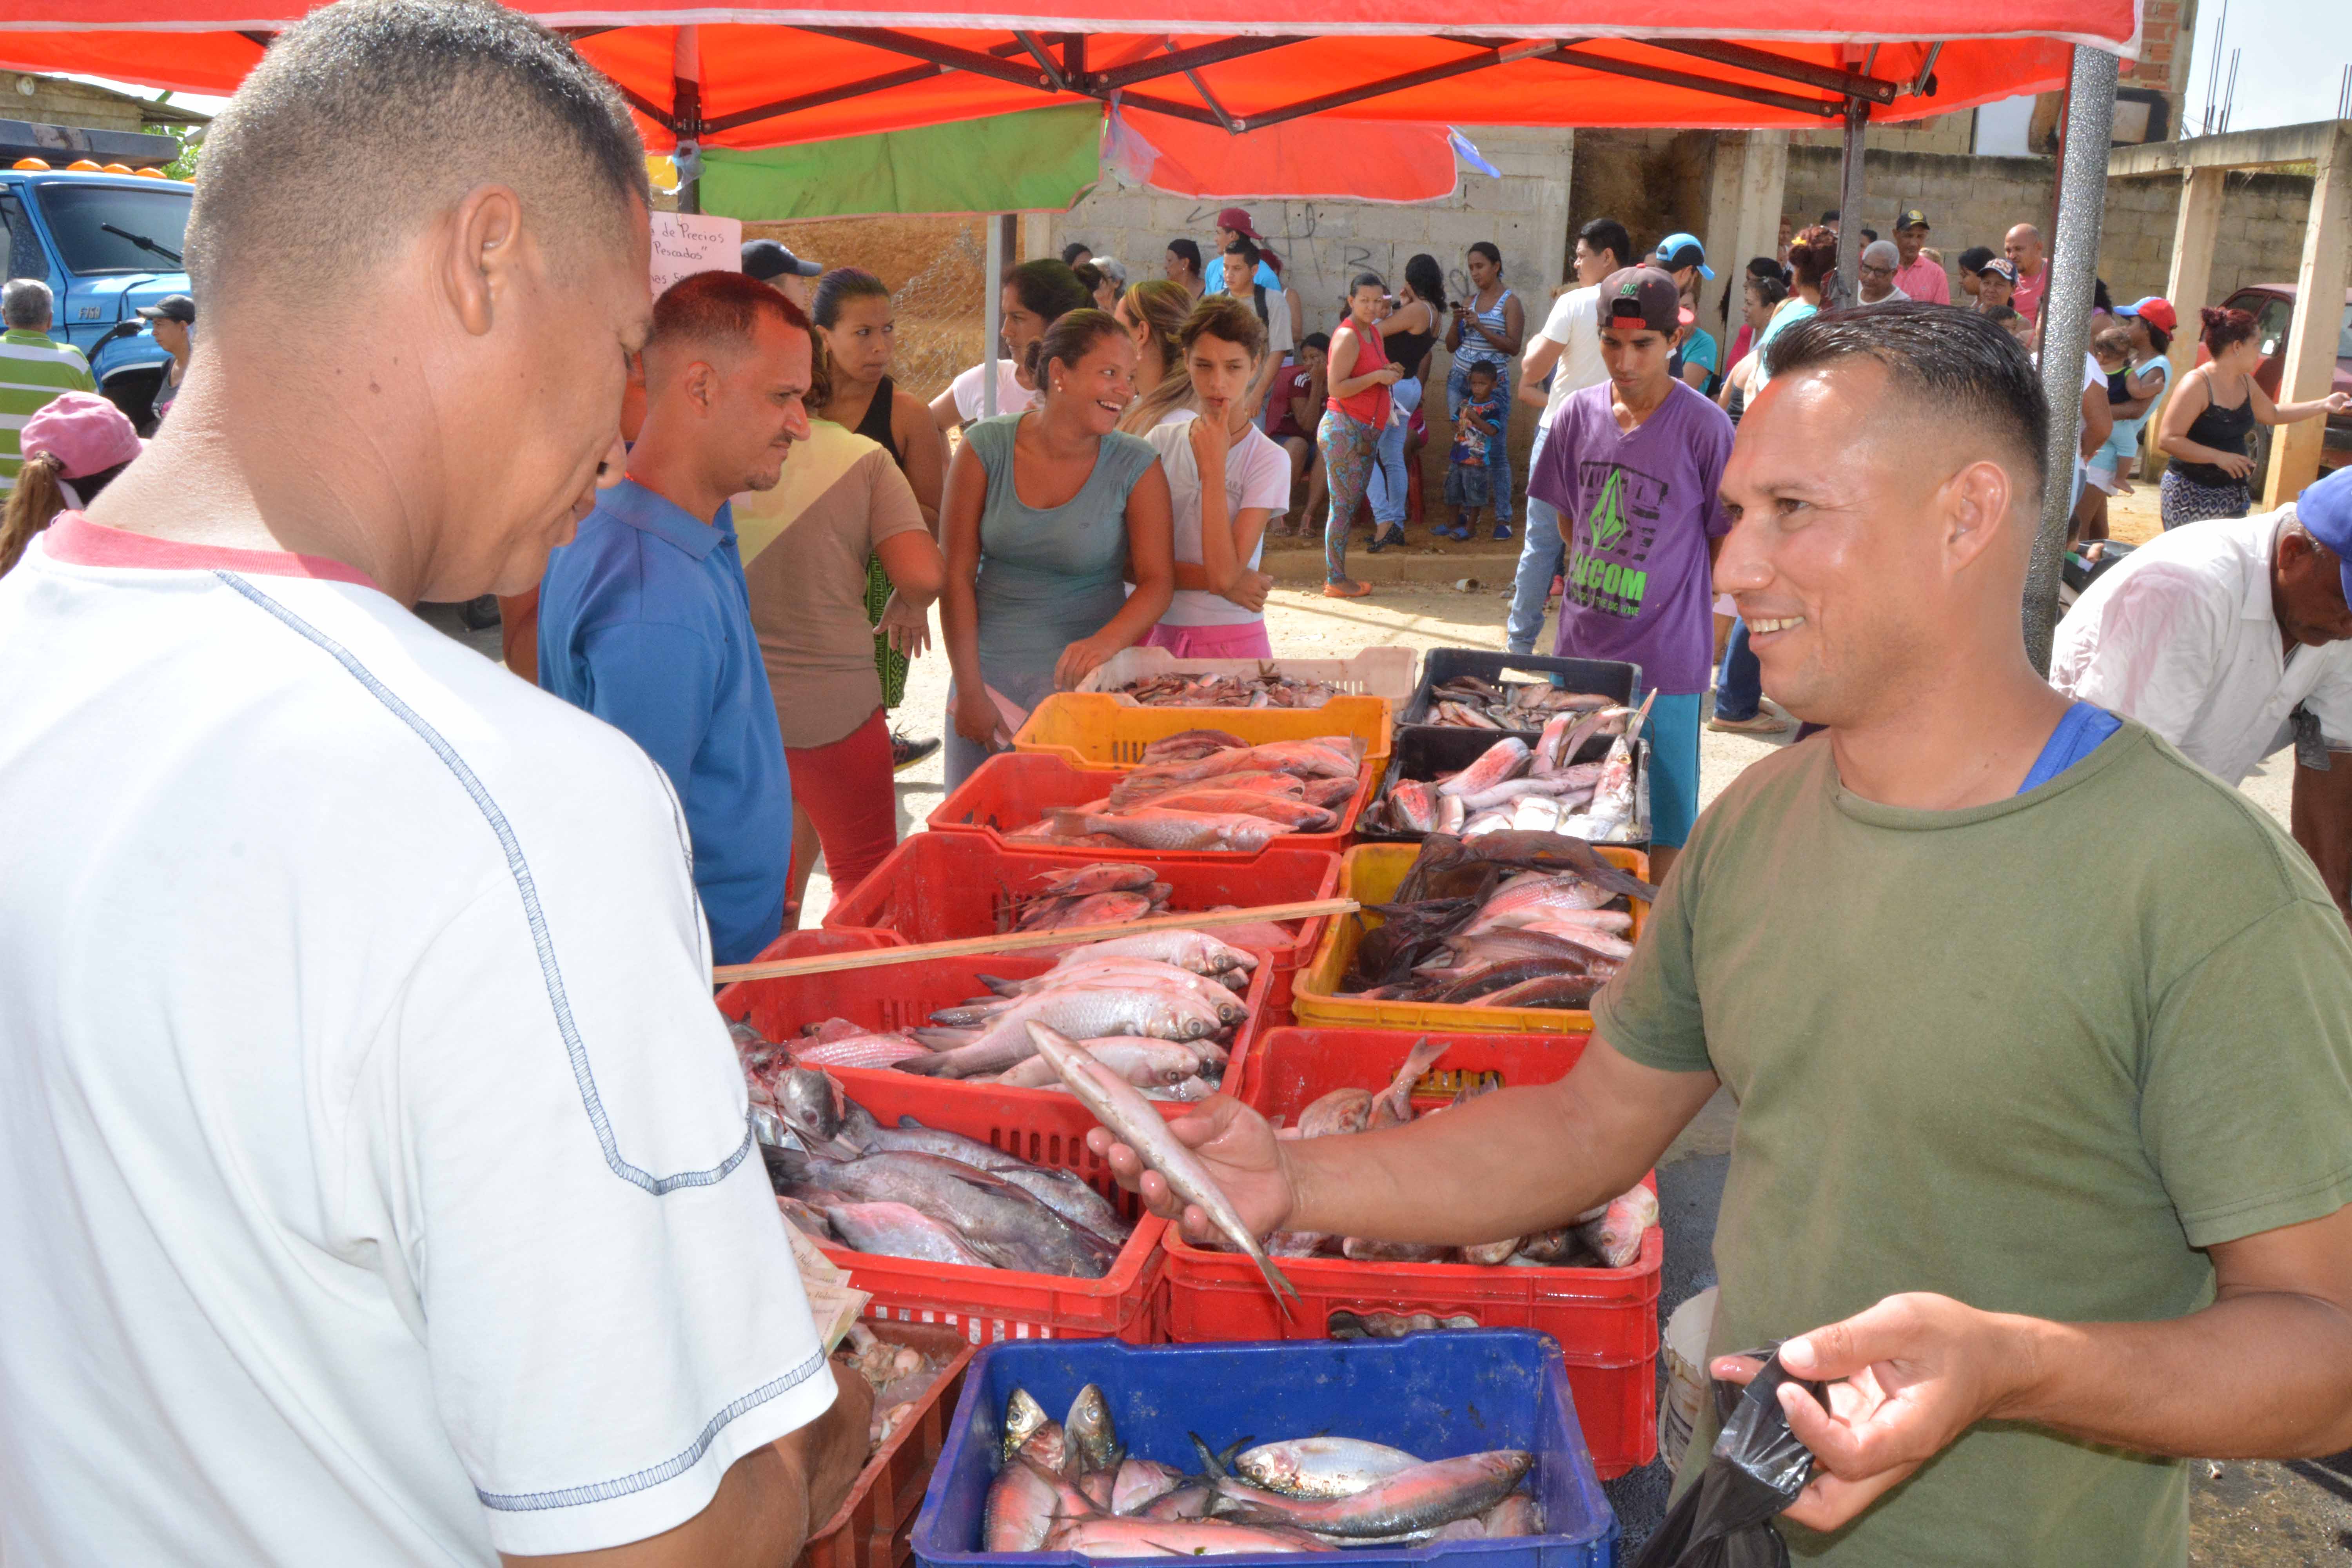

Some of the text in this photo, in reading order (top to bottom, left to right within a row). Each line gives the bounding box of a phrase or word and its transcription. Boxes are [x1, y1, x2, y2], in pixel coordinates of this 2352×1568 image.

[662, 222, 675, 238] de
[680, 223, 724, 243] Precios
[1621, 283, 1637, 295] DC
[1621, 605, 1640, 617] WAVE
